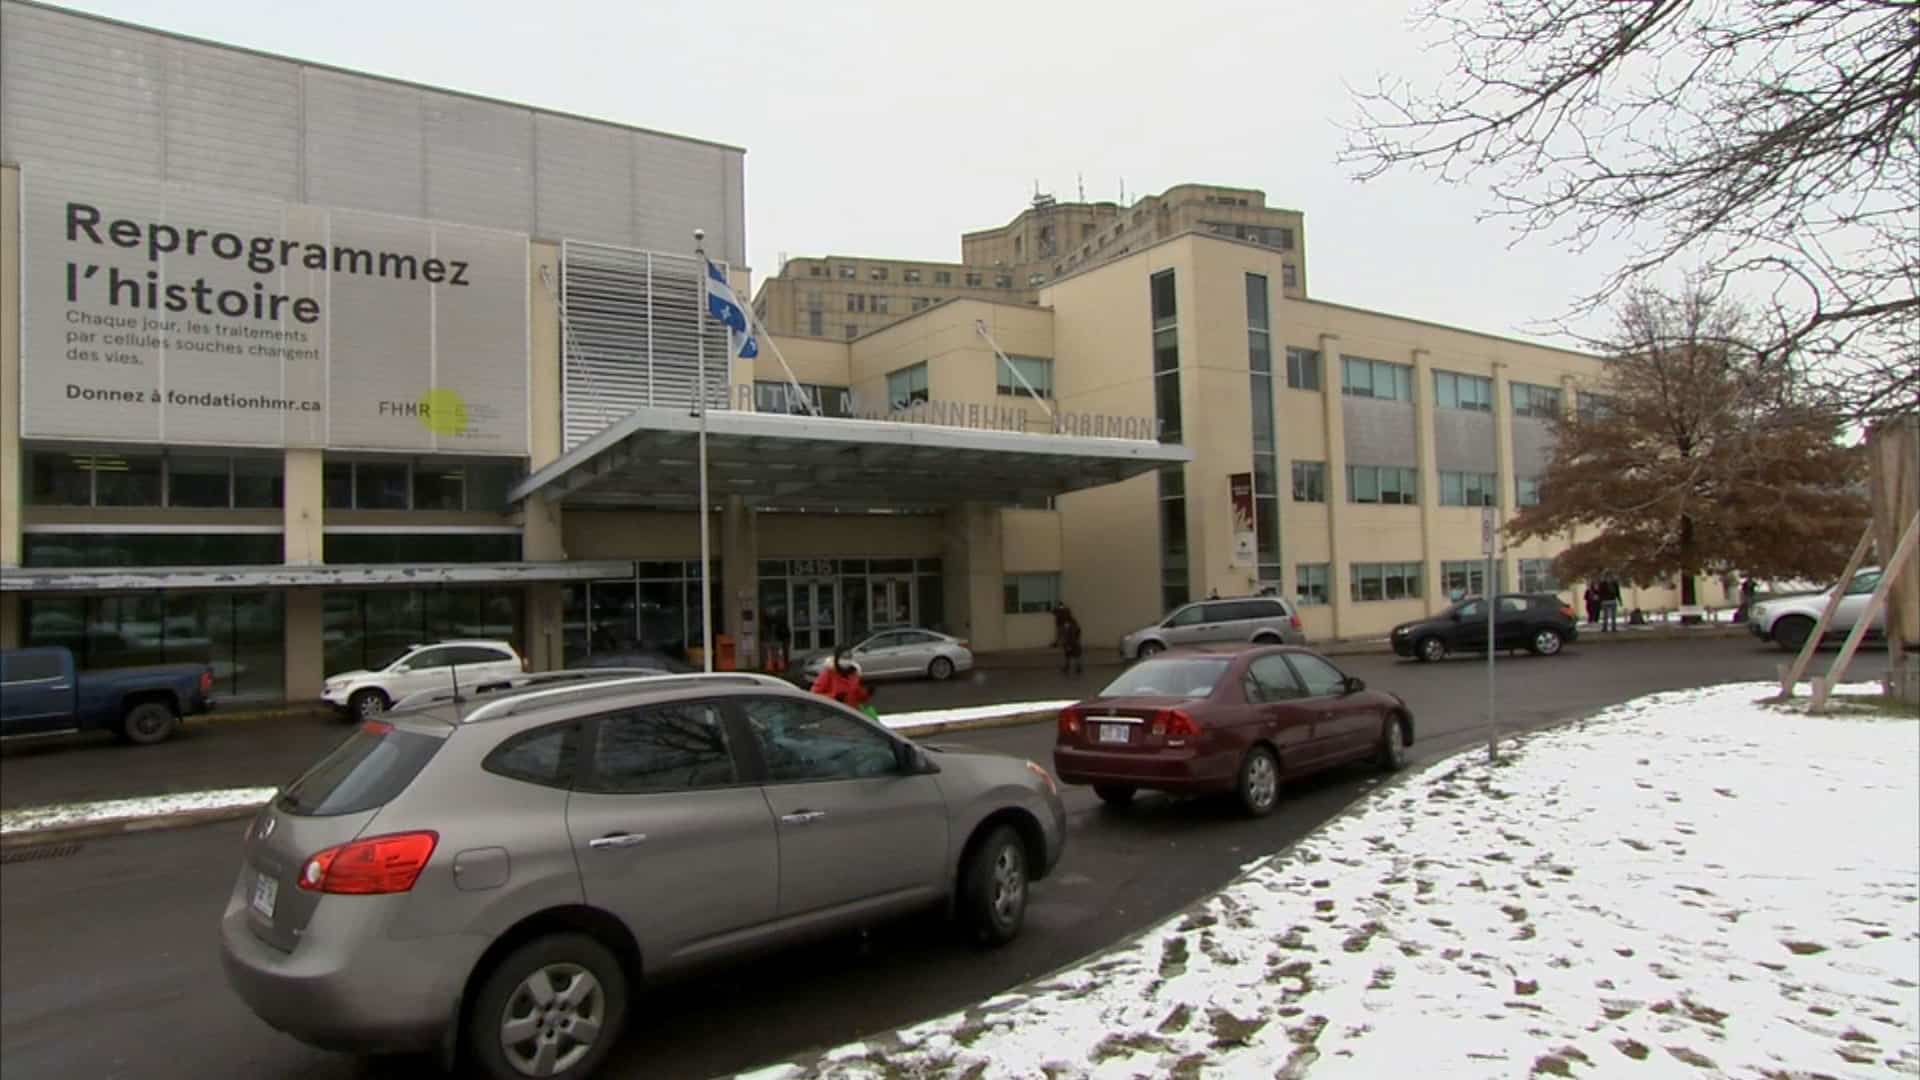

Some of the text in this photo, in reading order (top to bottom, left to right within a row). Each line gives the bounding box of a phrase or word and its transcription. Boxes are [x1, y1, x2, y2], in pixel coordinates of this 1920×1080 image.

[66, 202, 469, 285] Reprogrammez
[66, 263, 320, 323] l'histoire
[66, 310, 307, 342] Chaque jour, les traitements
[66, 331, 319, 360] par cellules souches changent
[66, 348, 143, 365] des vies.
[66, 384, 321, 411] Donnez à fondationhmr.ca
[379, 399, 432, 420] FHMR
